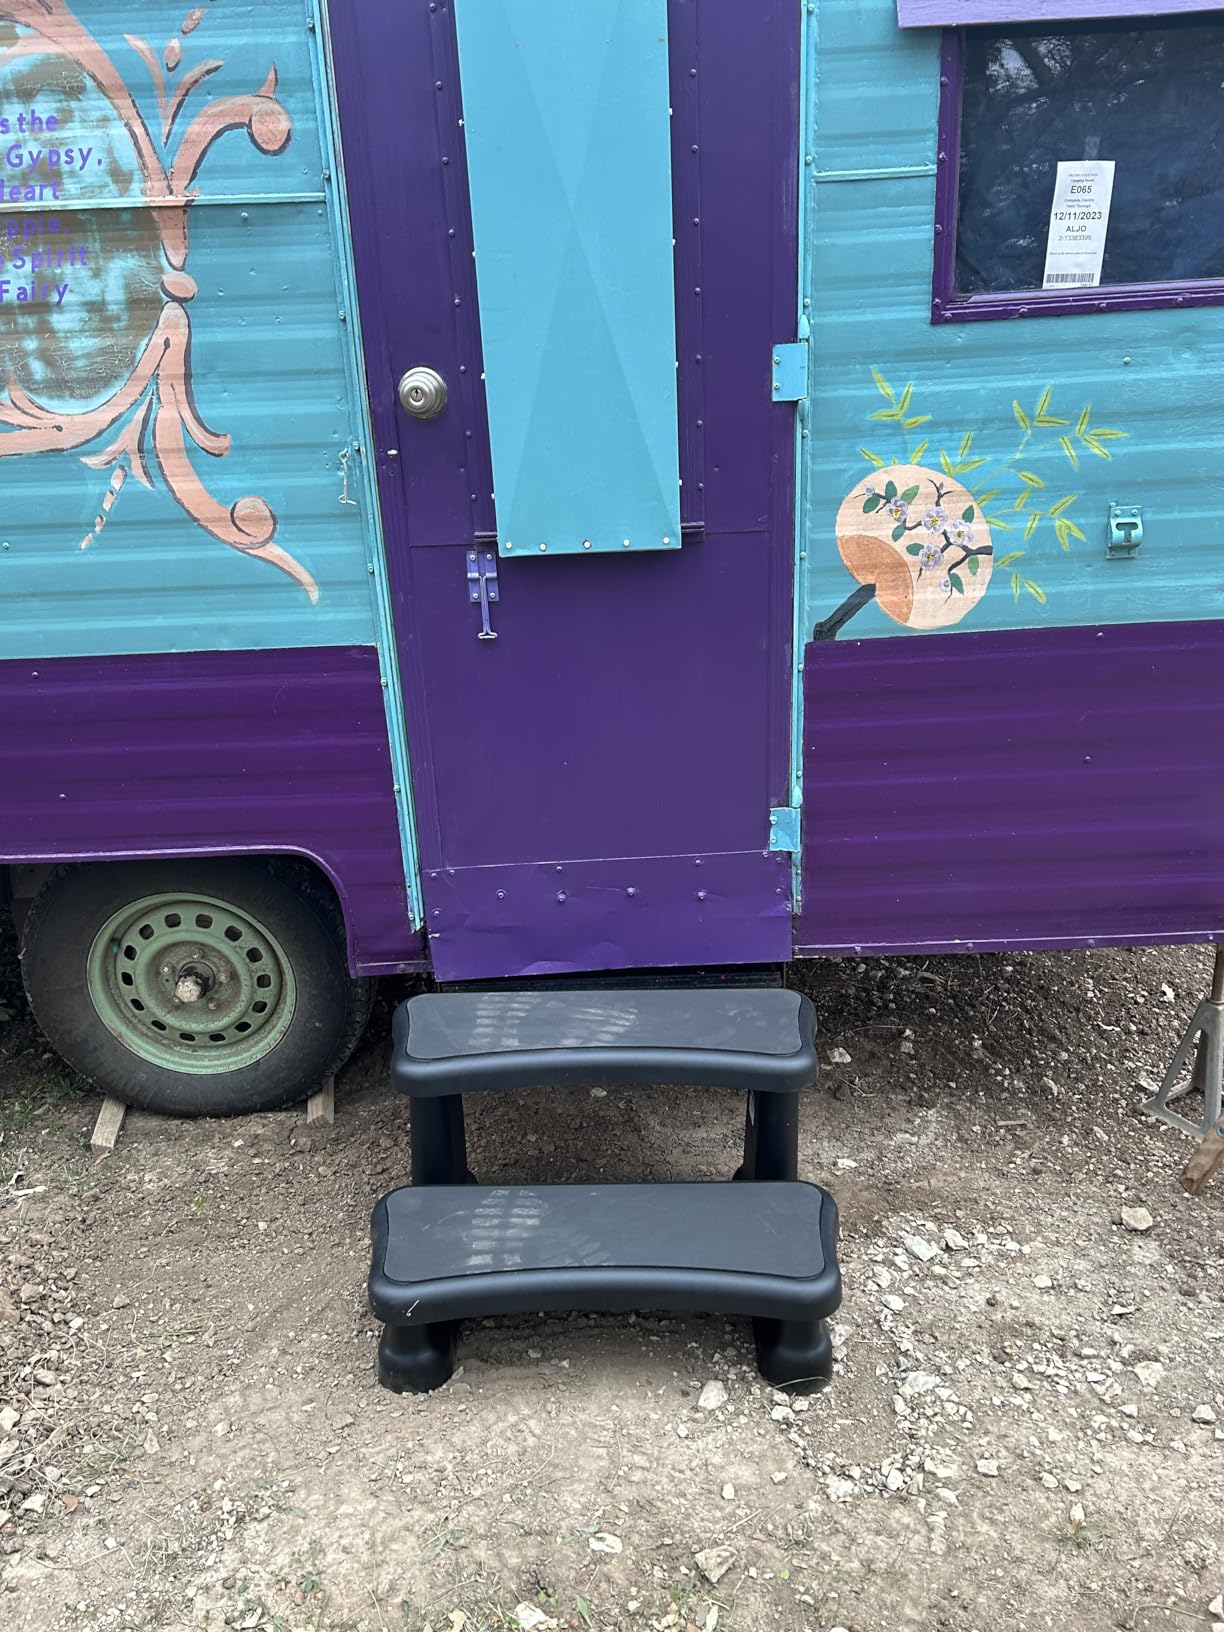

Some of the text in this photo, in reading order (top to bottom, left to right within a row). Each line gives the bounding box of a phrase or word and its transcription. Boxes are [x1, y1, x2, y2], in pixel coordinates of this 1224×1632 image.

[17, 109, 59, 134] the
[6, 143, 103, 174] Gypsy,
[1070, 185, 1092, 194] E065
[1054, 211, 1102, 221] 12/11/2023
[12, 243, 88, 274] Spirit
[0, 280, 69, 305] Fairy
